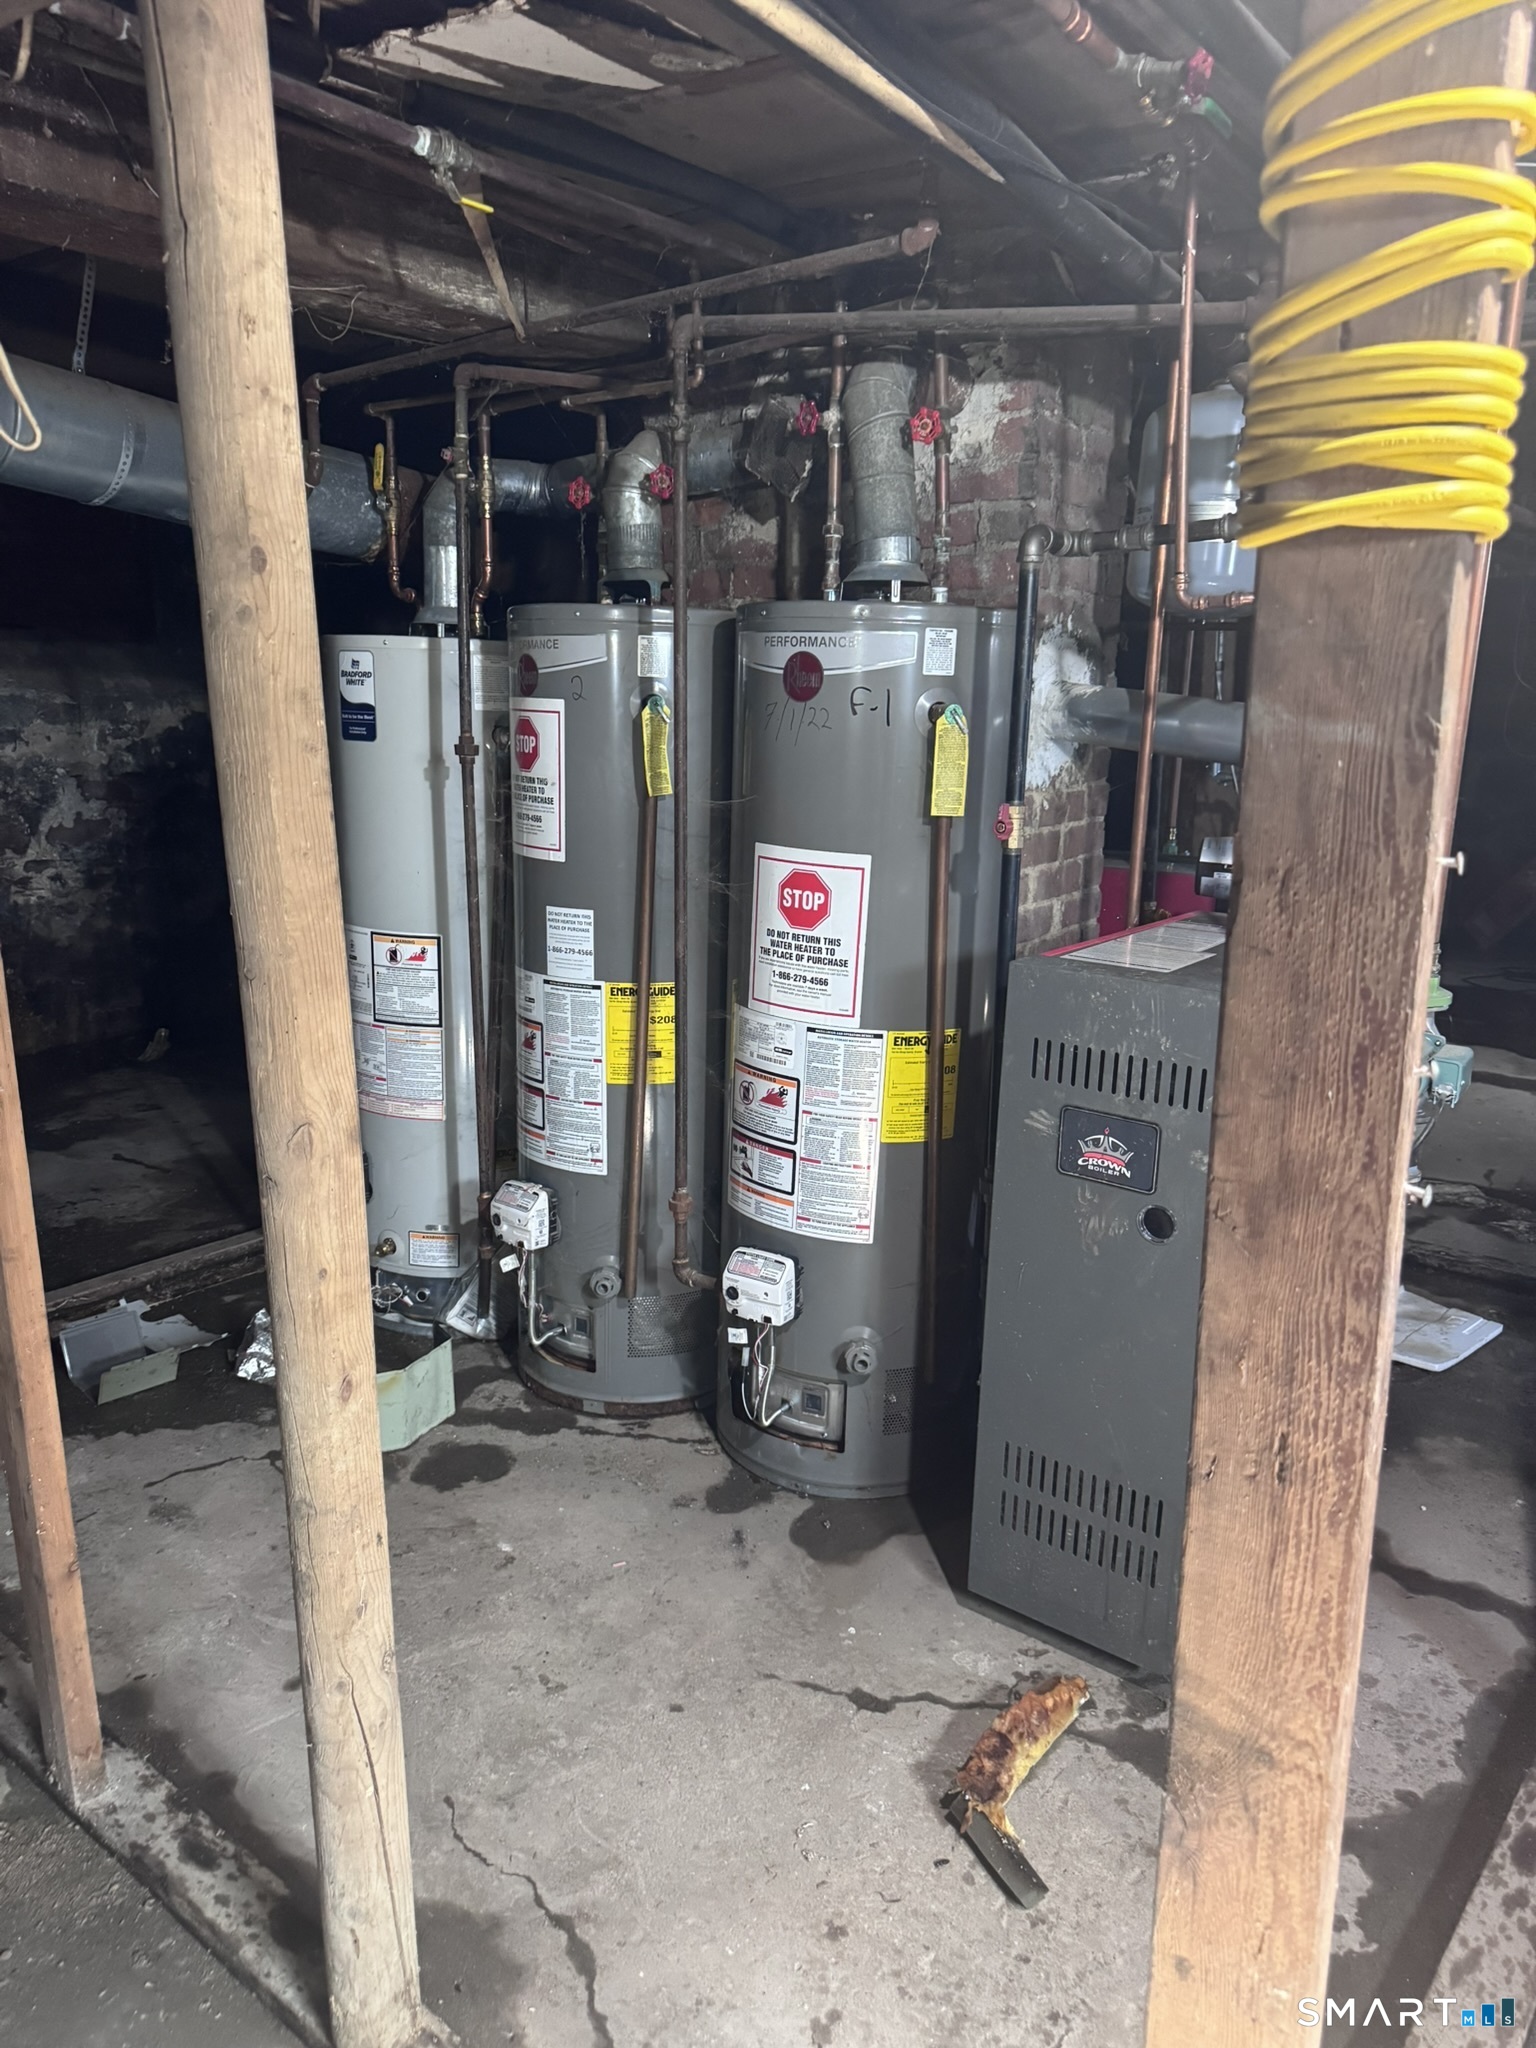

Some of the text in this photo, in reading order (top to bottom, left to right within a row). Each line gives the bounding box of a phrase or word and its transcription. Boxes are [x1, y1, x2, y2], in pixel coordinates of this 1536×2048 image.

[764, 636, 857, 648] PERFORMANCE
[341, 669, 372, 679] BRADFORD
[346, 678, 365, 686] WHITE
[571, 675, 587, 701] 2
[850, 686, 891, 727] F-1
[764, 697, 833, 747] 7/1/22
[514, 733, 536, 753] STOP
[782, 888, 826, 911] STOP
[767, 928, 842, 948] DO NOT RETURN THIS
[770, 938, 836, 957] WATER HEATER TO
[548, 946, 593, 956] 1-866-279-4566
[760, 946, 770, 956] THE
[772, 948, 794, 960] PLACE
[796, 953, 804, 962] OF
[807, 955, 849, 968] PURCHASE
[772, 970, 830, 987] 1-866-279-4566
[753, 1070, 776, 1084] WARNING
[1078, 1157, 1131, 1178] CROWN
[1088, 1165, 1120, 1176] BOILER
